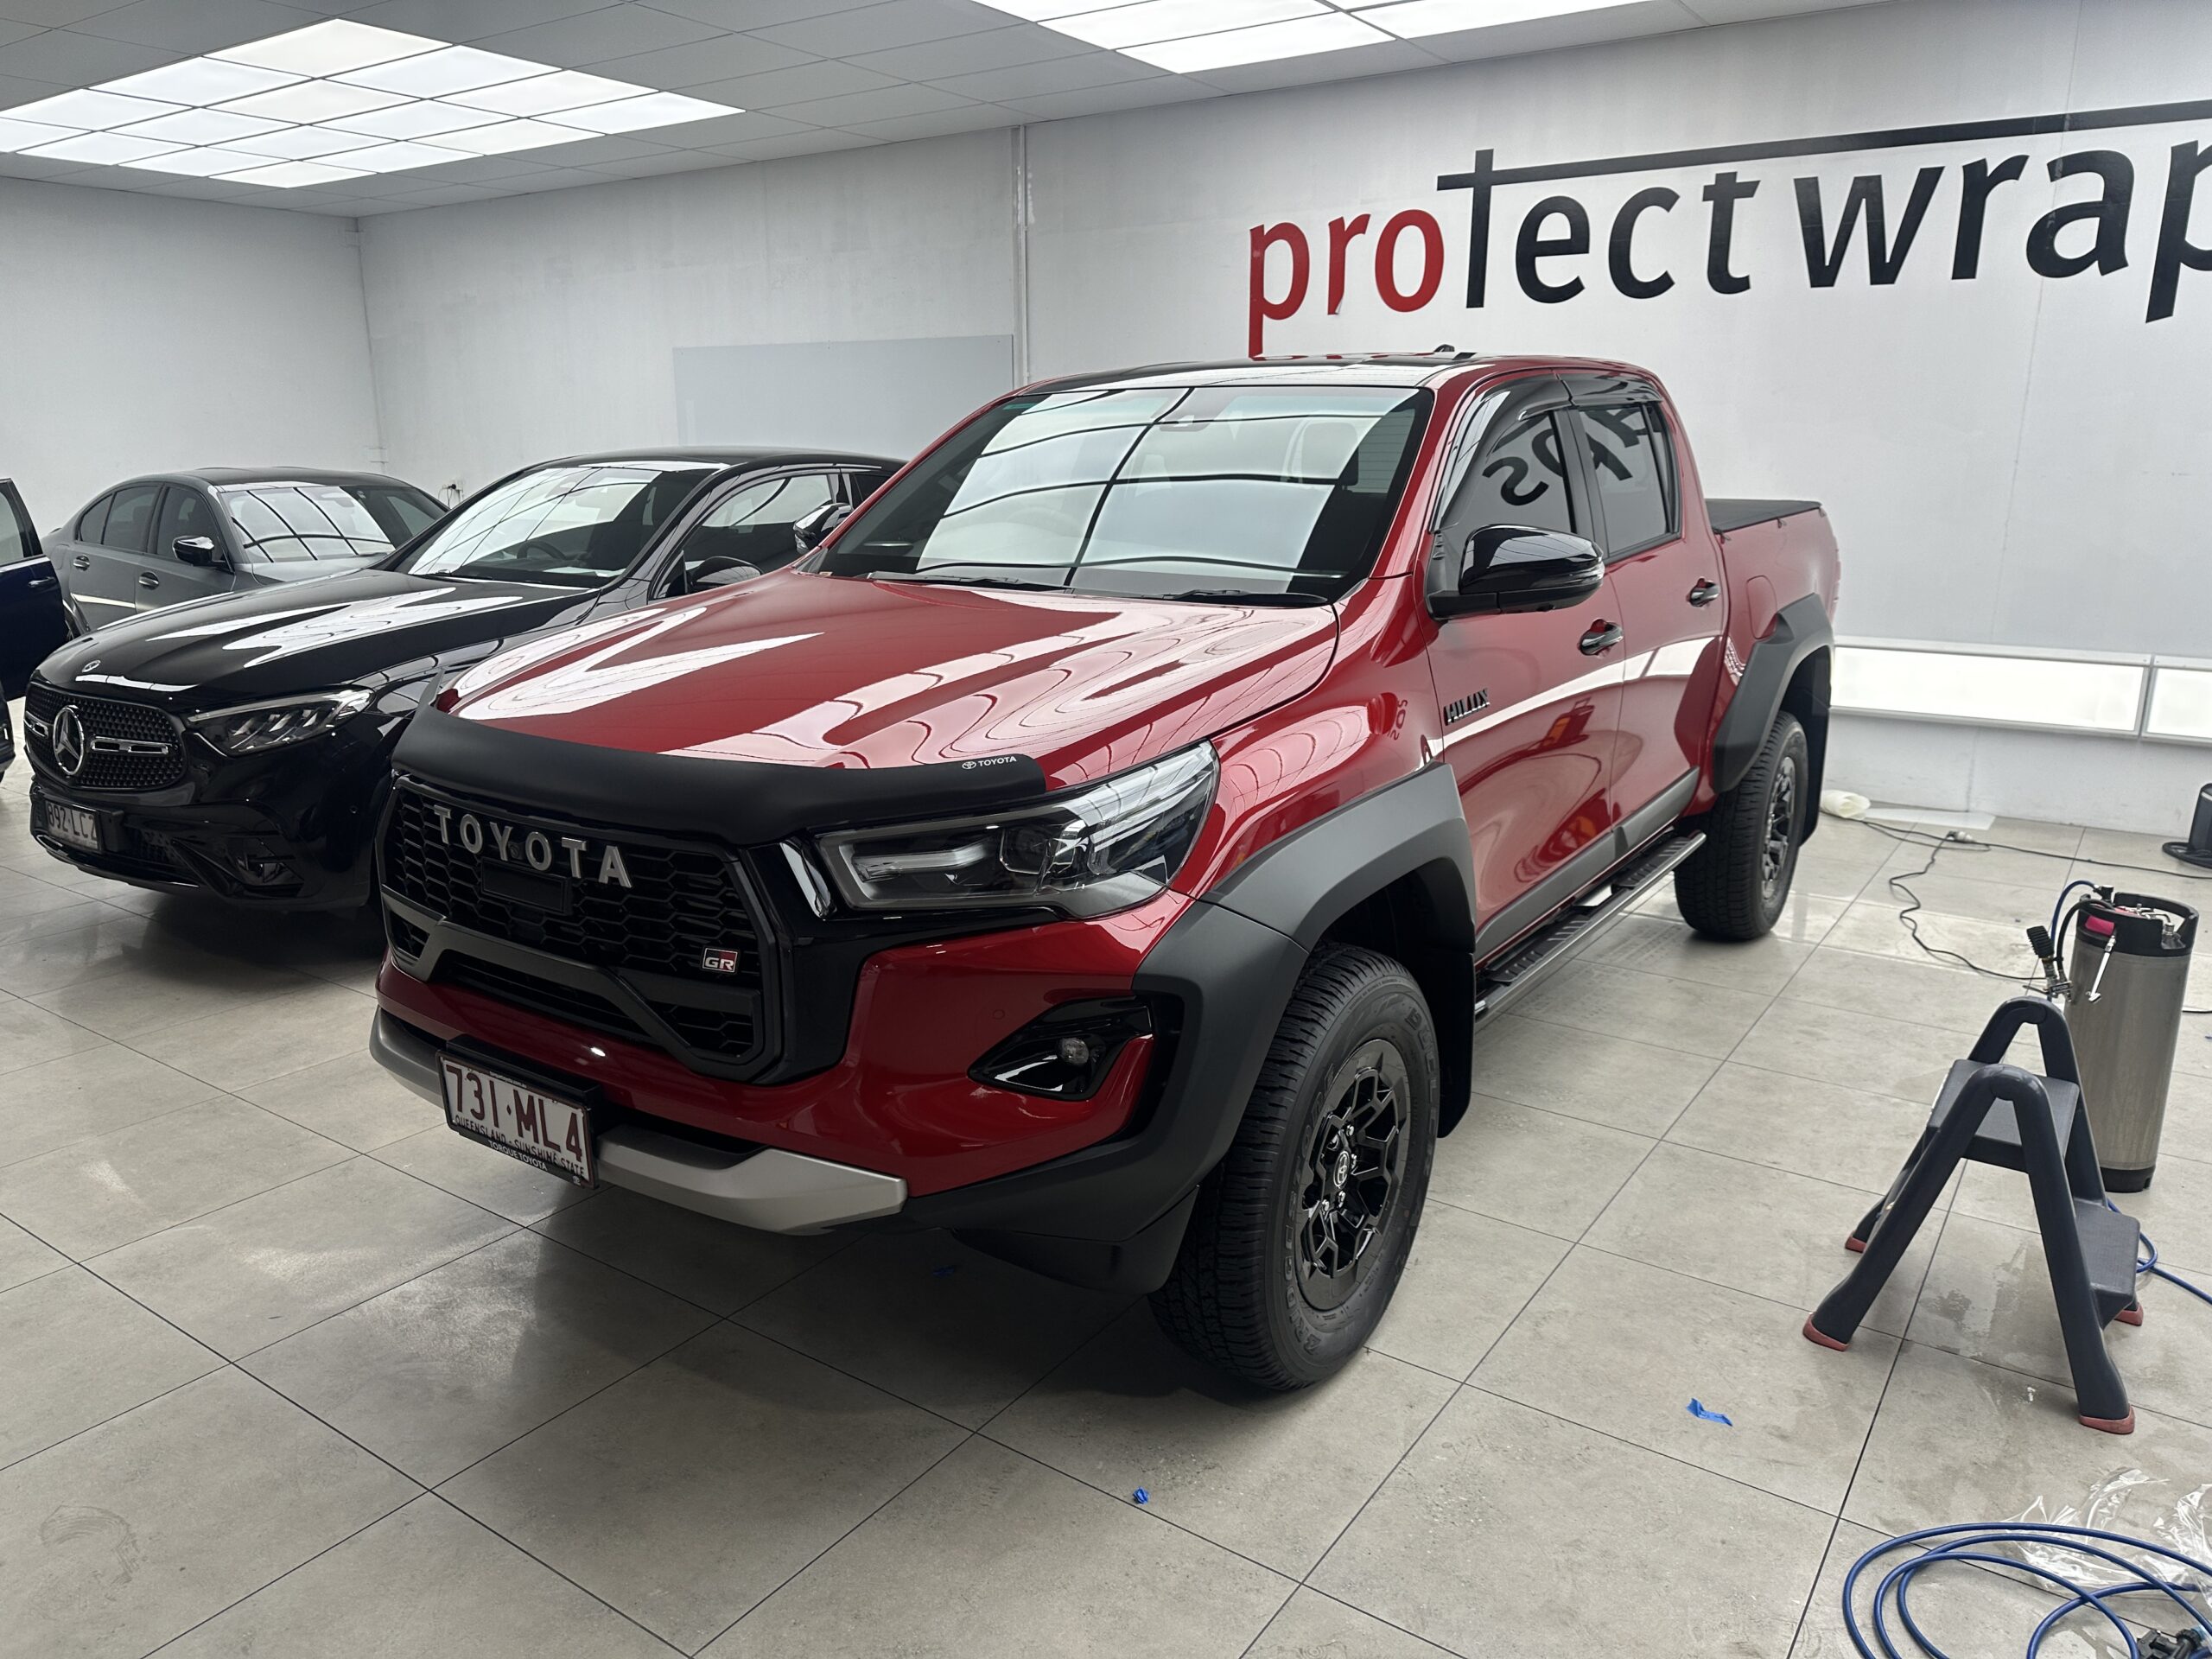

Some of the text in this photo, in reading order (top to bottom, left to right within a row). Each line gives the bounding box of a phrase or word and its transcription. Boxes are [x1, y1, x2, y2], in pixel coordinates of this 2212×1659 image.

[1249, 140, 2212, 358] protect wrap
[1443, 688, 1491, 726] HILUX
[978, 756, 1017, 767] TOYOTA
[434, 804, 632, 888] TOYOTA
[704, 957, 734, 971] GR
[454, 1115, 507, 1145] QUEENSLAND
[514, 1137, 558, 1166] SUNSHINE
[561, 1156, 585, 1178] STATE
[488, 1140, 548, 1172] TORQUE TOYOTA
